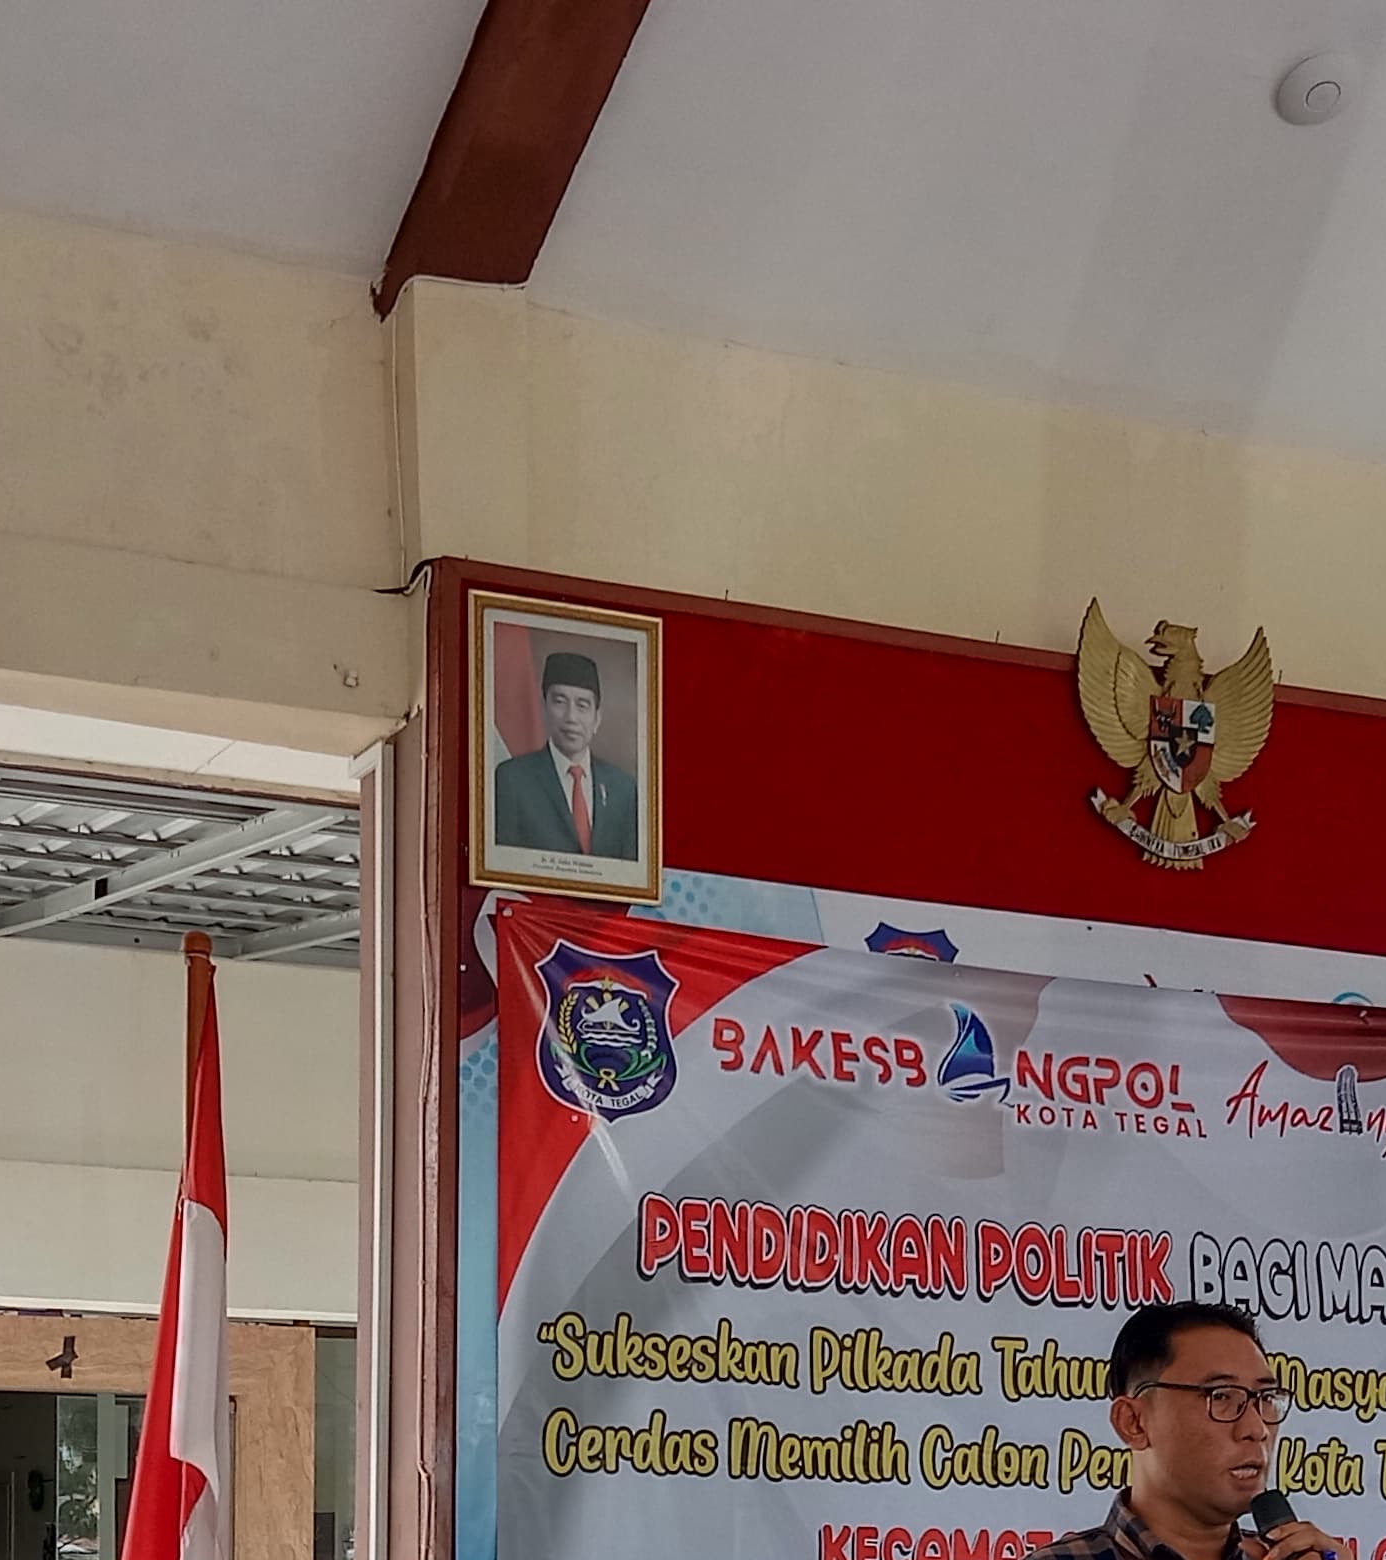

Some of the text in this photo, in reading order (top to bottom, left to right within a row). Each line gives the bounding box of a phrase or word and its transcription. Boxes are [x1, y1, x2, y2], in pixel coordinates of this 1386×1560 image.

[611, 1091, 643, 1108] TEGAL
[1017, 1104, 1207, 1138] KOTA TEGAL
[637, 1193, 967, 1297] PENDIDIKAN
[978, 1217, 1174, 1308] POLITIK
[1190, 1231, 1310, 1321] BAGI
[811, 1328, 981, 1395] Pilkada
[543, 1408, 718, 1477] Cerdas
[727, 1417, 909, 1484] Memilih
[920, 1425, 1049, 1491] Calon
[1276, 1437, 1364, 1496] Kota
